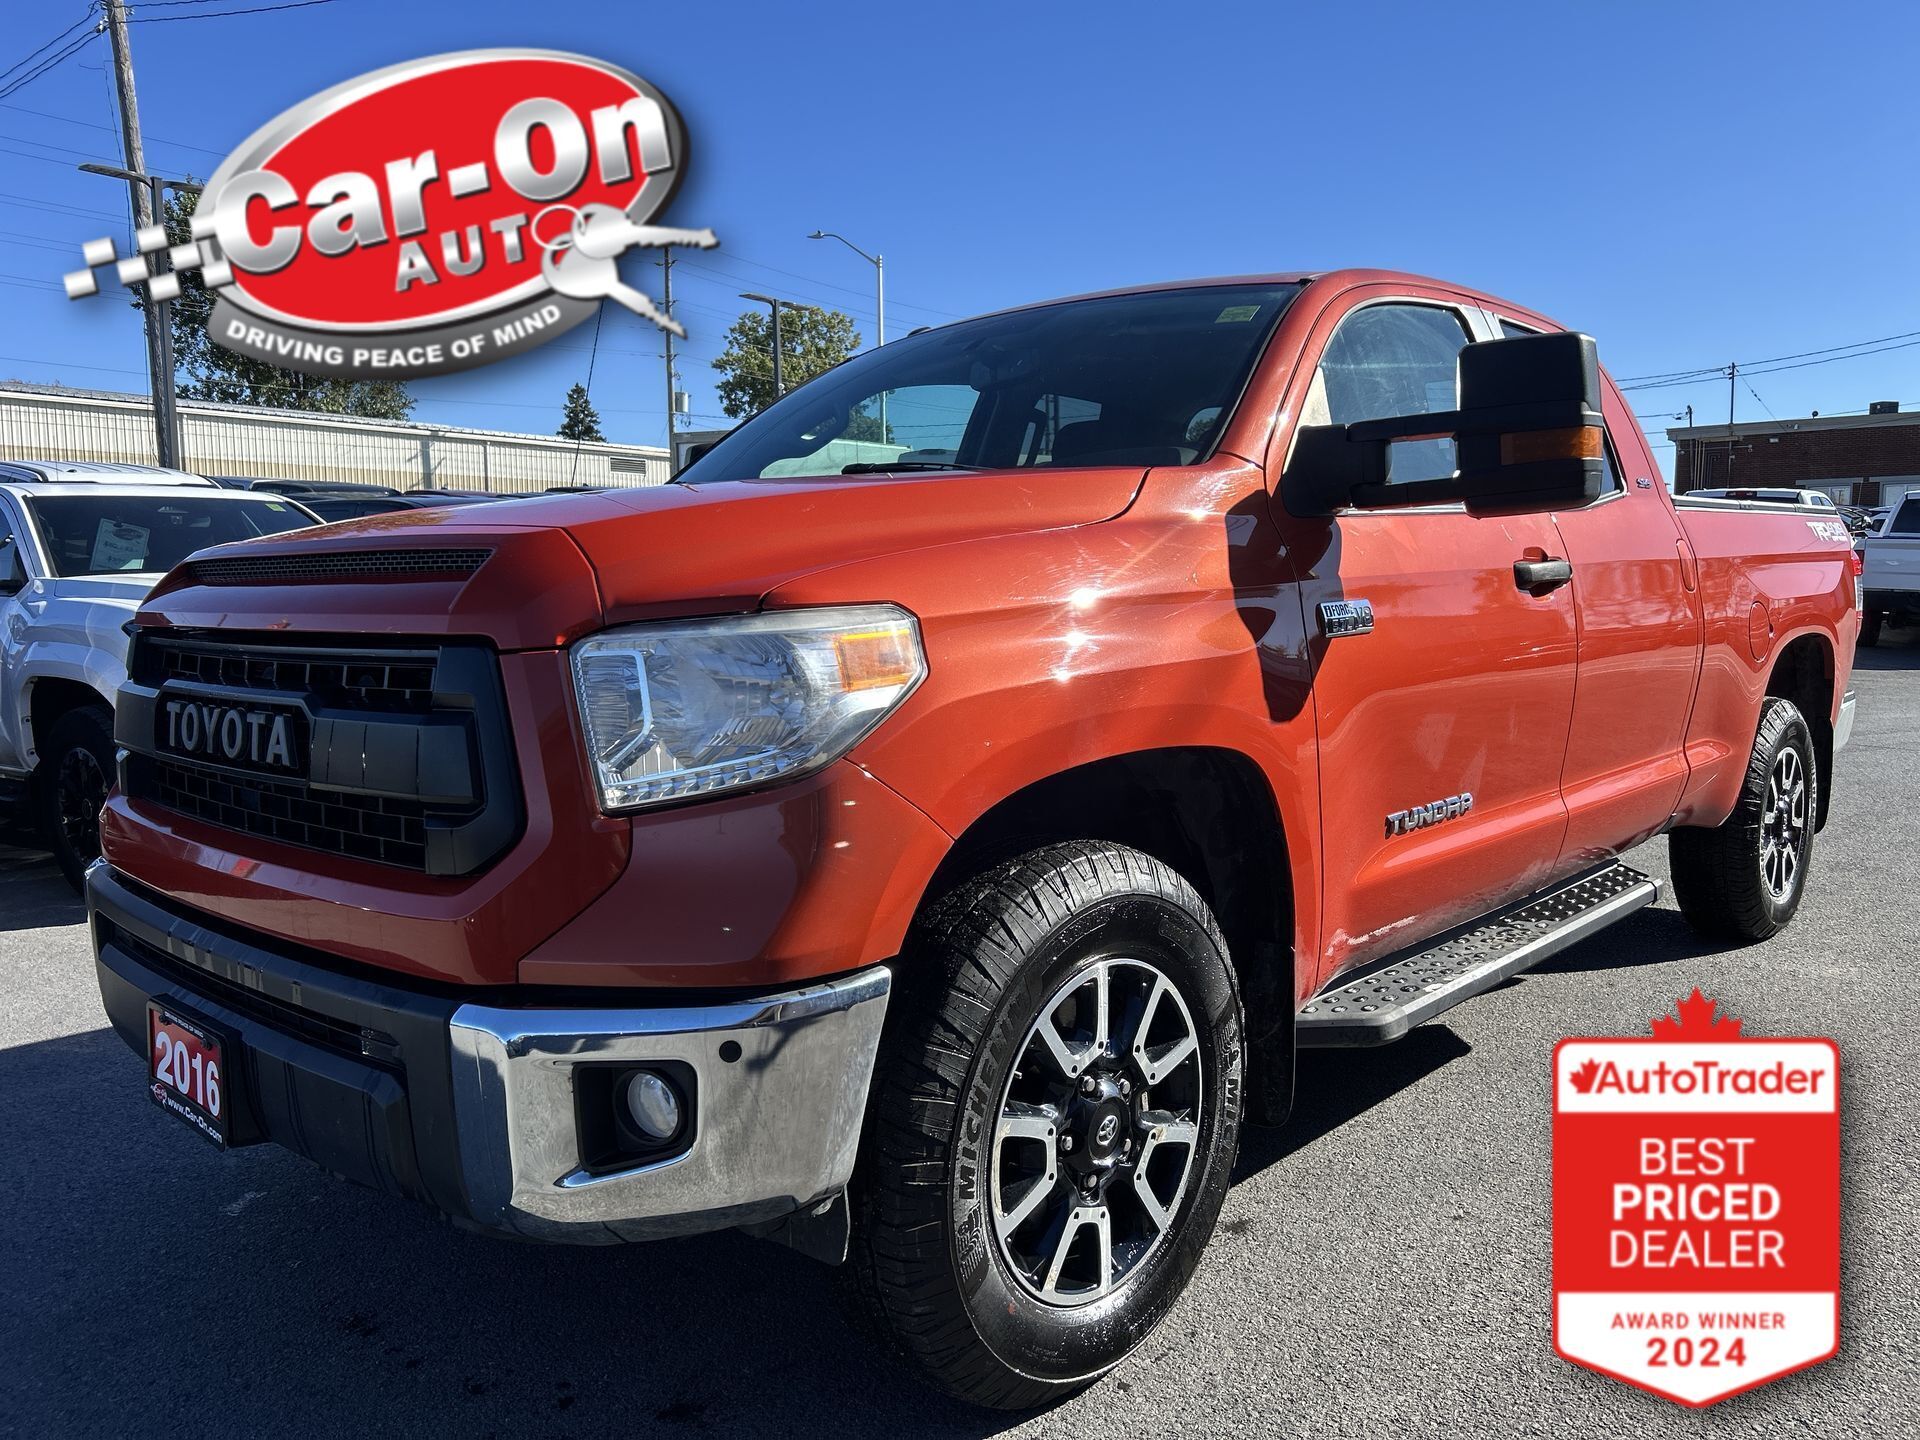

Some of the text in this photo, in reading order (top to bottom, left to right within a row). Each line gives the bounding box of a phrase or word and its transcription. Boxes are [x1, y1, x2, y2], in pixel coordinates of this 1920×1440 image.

[167, 701, 296, 767] TOYOTA
[1386, 792, 1474, 838] TUNDRA
[155, 1031, 220, 1117] 2016
[167, 1097, 223, 1144] www.Car-On.com
